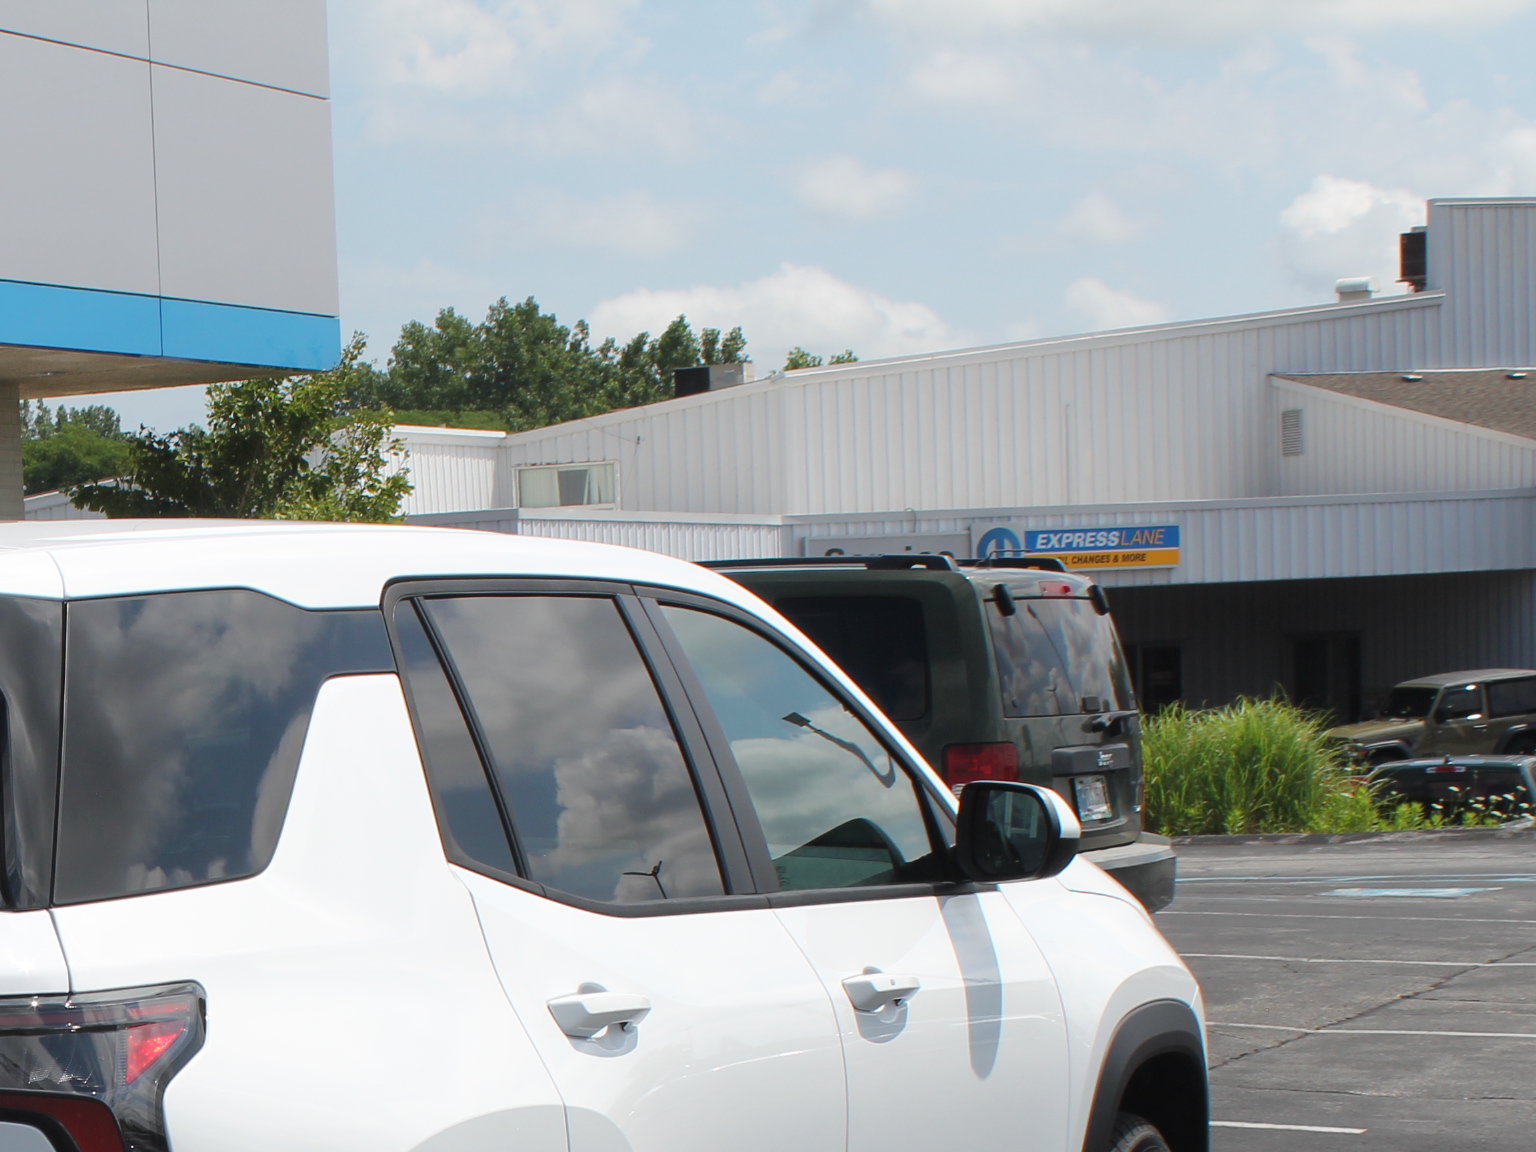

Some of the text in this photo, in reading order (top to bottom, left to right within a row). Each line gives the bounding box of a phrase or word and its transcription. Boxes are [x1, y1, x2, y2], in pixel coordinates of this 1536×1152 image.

[1071, 555, 1111, 563] CHANGES
[1113, 554, 1120, 562] &
[1121, 553, 1147, 562] MORE
